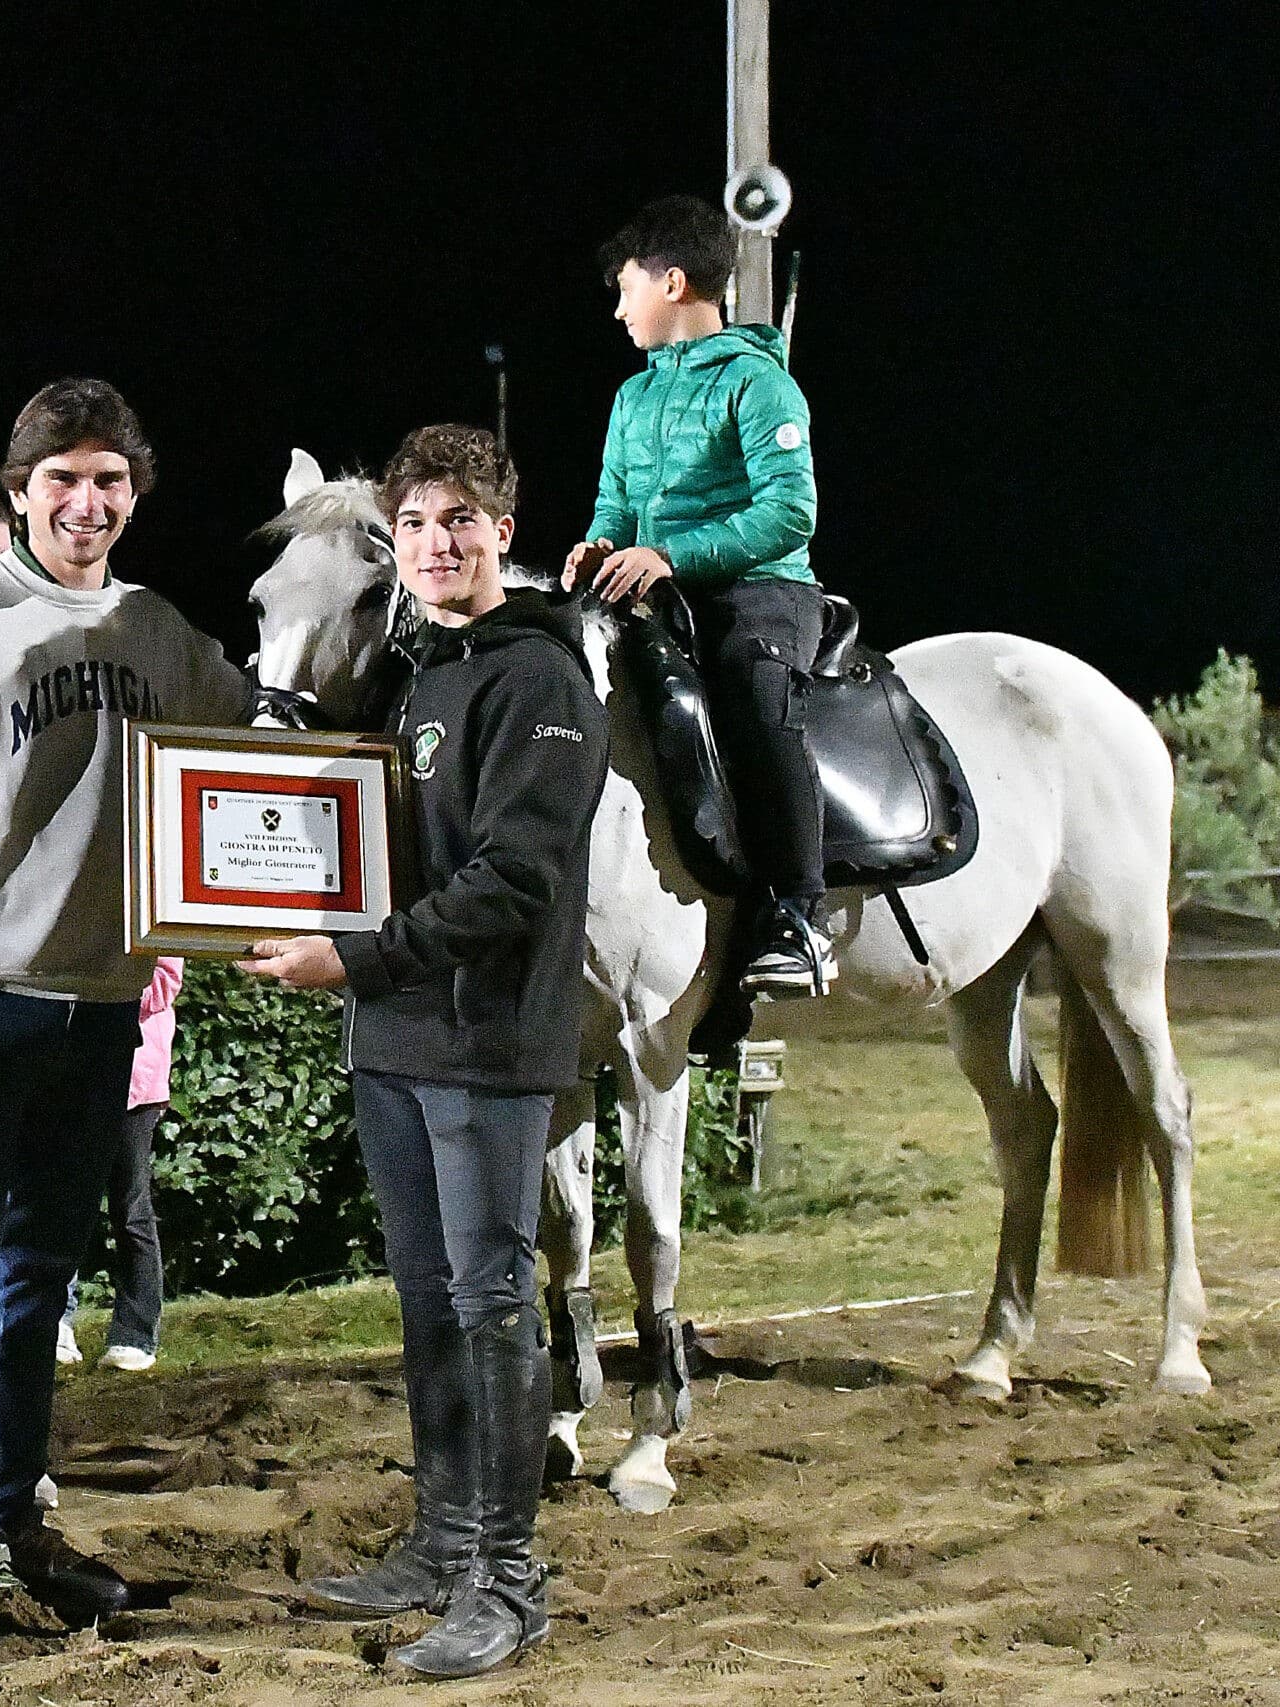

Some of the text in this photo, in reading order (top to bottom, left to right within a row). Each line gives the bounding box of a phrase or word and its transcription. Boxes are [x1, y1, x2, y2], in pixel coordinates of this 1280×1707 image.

[532, 724, 583, 742] Saverio
[220, 841, 266, 852] GIOSTRA
[268, 844, 279, 852] DI
[227, 856, 317, 870] Miglior Giostratore
